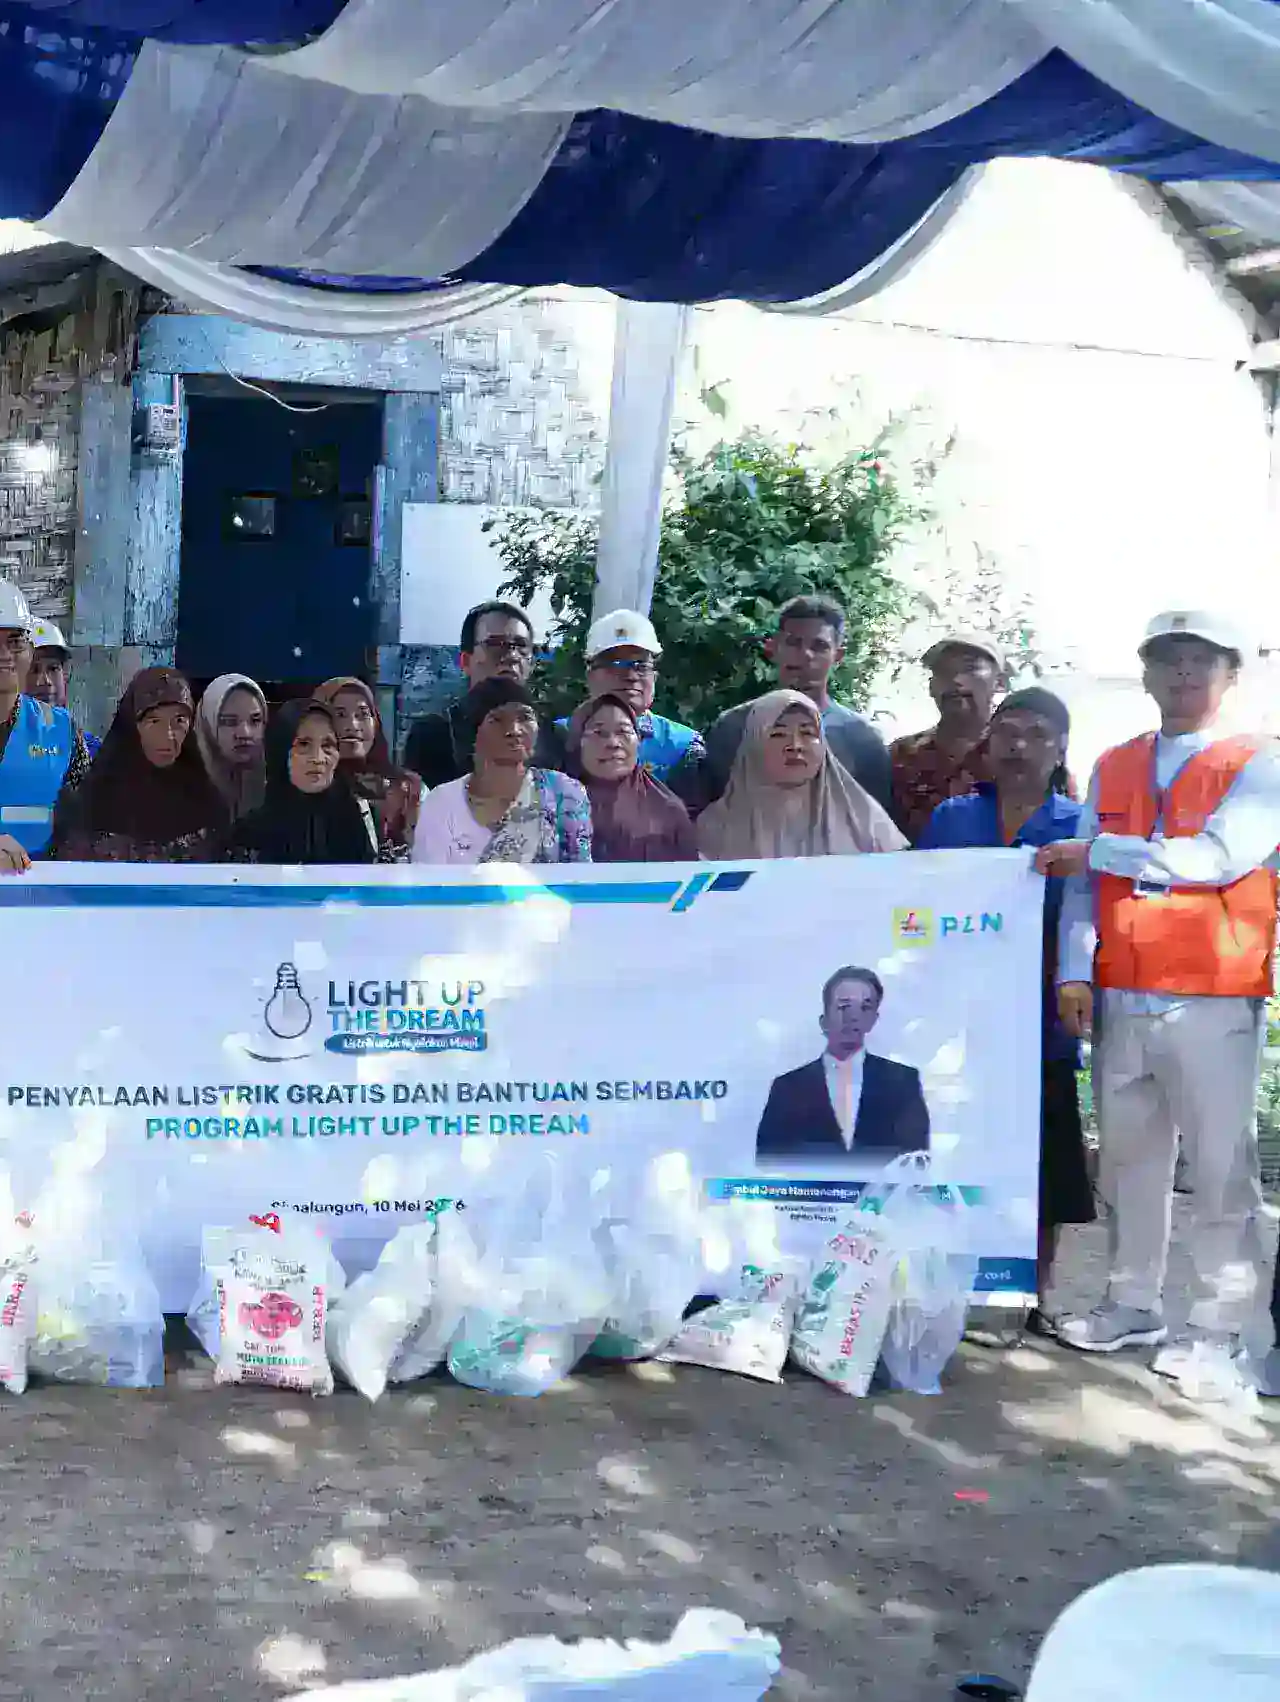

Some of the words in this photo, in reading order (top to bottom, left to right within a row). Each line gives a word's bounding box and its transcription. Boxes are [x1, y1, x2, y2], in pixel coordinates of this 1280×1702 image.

[940, 912, 1002, 936] PLN
[328, 980, 428, 1007] LIGHT
[442, 981, 485, 1006] UP
[326, 1009, 380, 1031] THE
[390, 1009, 485, 1031] DREAM
[8, 1085, 169, 1107] PENYALAAN
[177, 1084, 280, 1106] LISTRIK
[286, 1083, 385, 1105] GRATIS
[393, 1082, 448, 1103] DAN
[457, 1081, 588, 1103] BANTUAN
[596, 1080, 729, 1102] SEMBAKO
[146, 1117, 283, 1139] PROGRAM
[292, 1116, 376, 1138] LIGHT
[382, 1116, 419, 1136] UP
[425, 1115, 482, 1136] THE
[489, 1114, 590, 1136] DREAM
[373, 1200, 390, 1212] 10
[394, 1200, 420, 1212] Mei
[424, 1199, 465, 1212] 26
